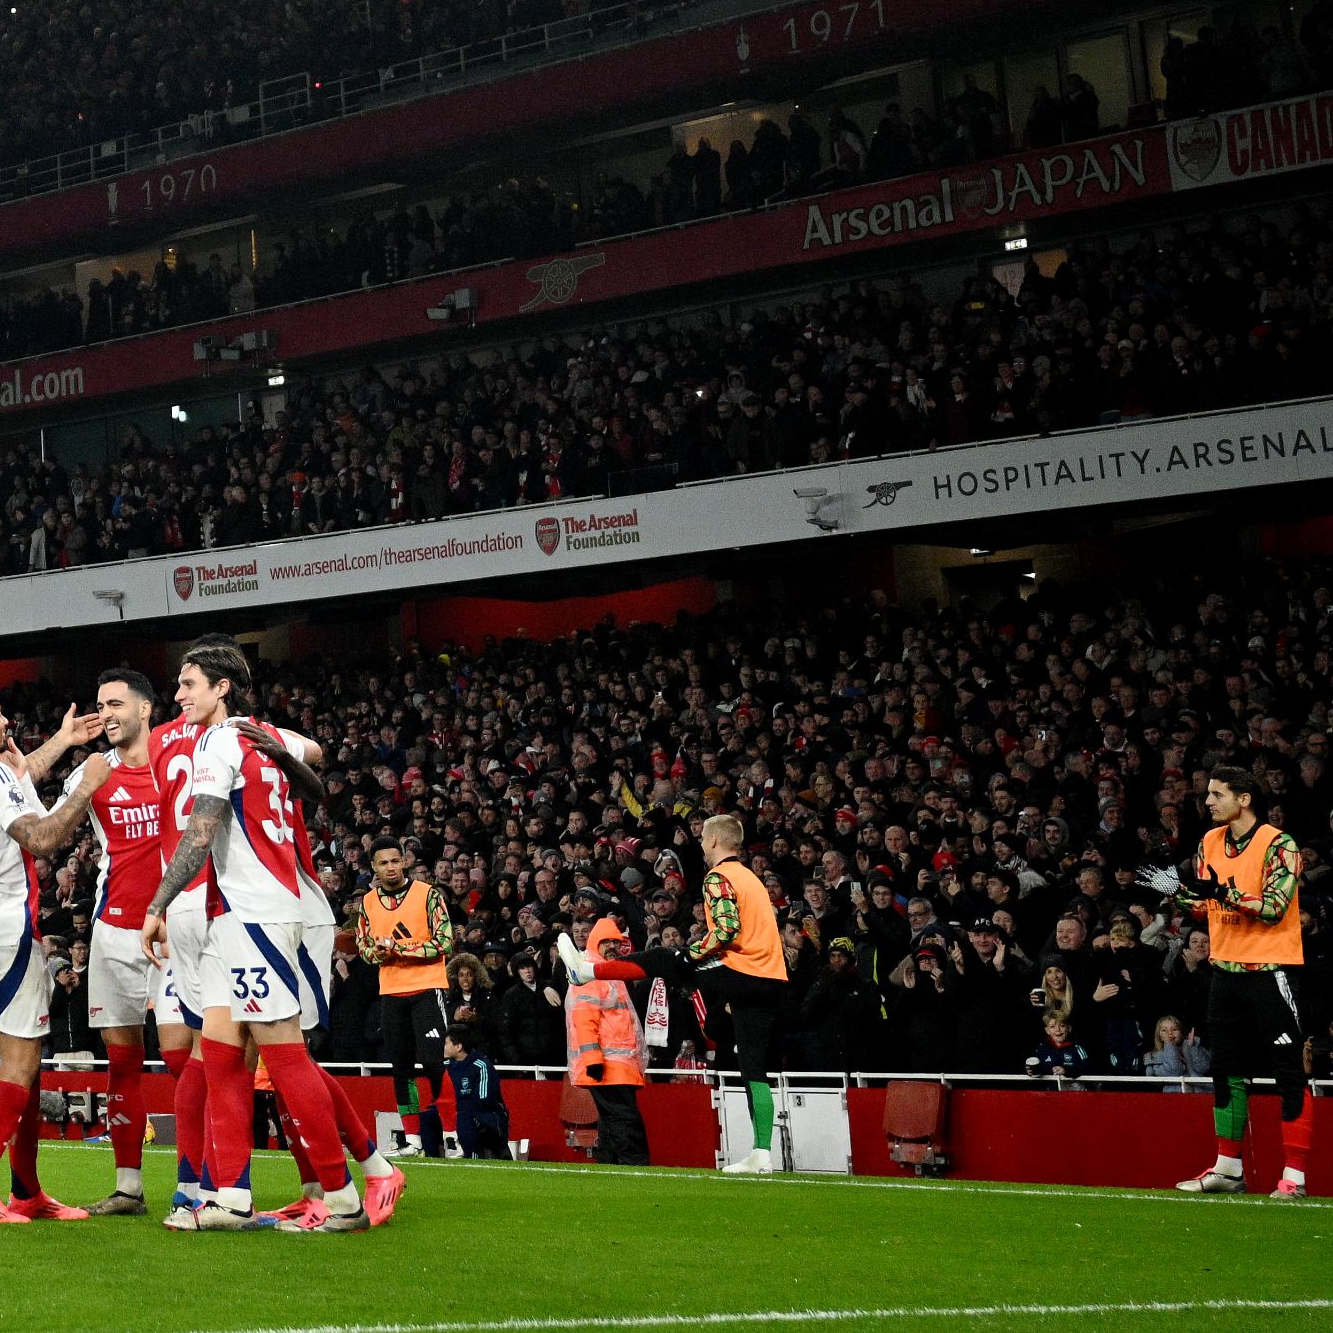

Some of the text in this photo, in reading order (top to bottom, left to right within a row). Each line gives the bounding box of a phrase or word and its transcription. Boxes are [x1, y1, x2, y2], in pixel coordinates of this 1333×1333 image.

[141, 163, 217, 211] 1970
[803, 138, 1147, 251] Arsenal JAPAN
[933, 425, 1333, 501] HOSPITALITY.ARSENAL
[563, 509, 639, 533] The Arsenal
[565, 529, 641, 551] Foundation
[269, 532, 524, 581] www.arsenal.com/thearsenalfoundation
[195, 559, 258, 582] The Arsenal
[198, 577, 260, 597] Foundation
[108, 802, 160, 824] Emir
[125, 820, 160, 839] FLY BE
[974, 917, 991, 926] AFC
[231, 966, 270, 999] 33
[796, 1094, 802, 1107] 3
